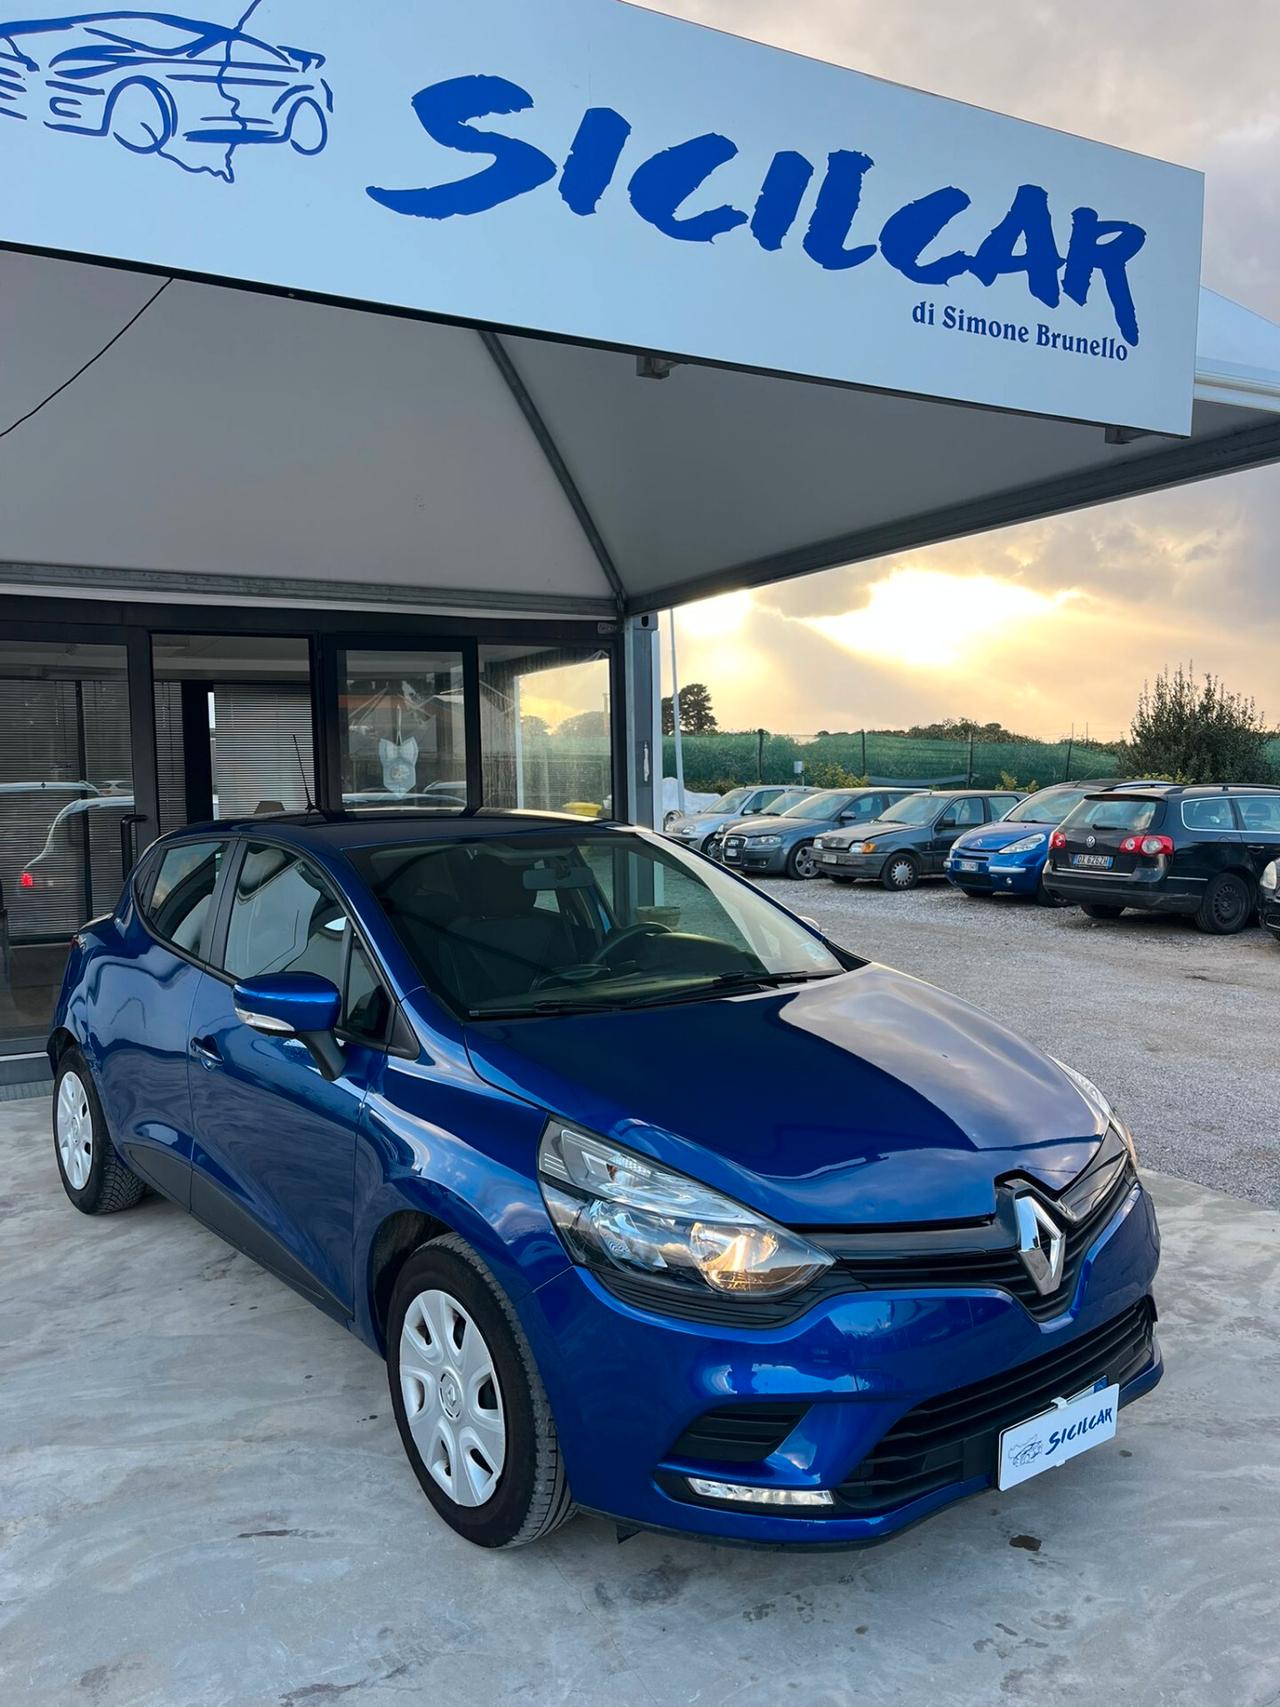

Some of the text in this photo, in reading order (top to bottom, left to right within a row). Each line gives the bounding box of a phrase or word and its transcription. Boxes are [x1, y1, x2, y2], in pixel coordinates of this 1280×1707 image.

[366, 75, 1145, 346] SICILCAR
[911, 301, 1128, 361] di Simone Brunello
[1045, 1407, 1113, 1455] SICILCAR
